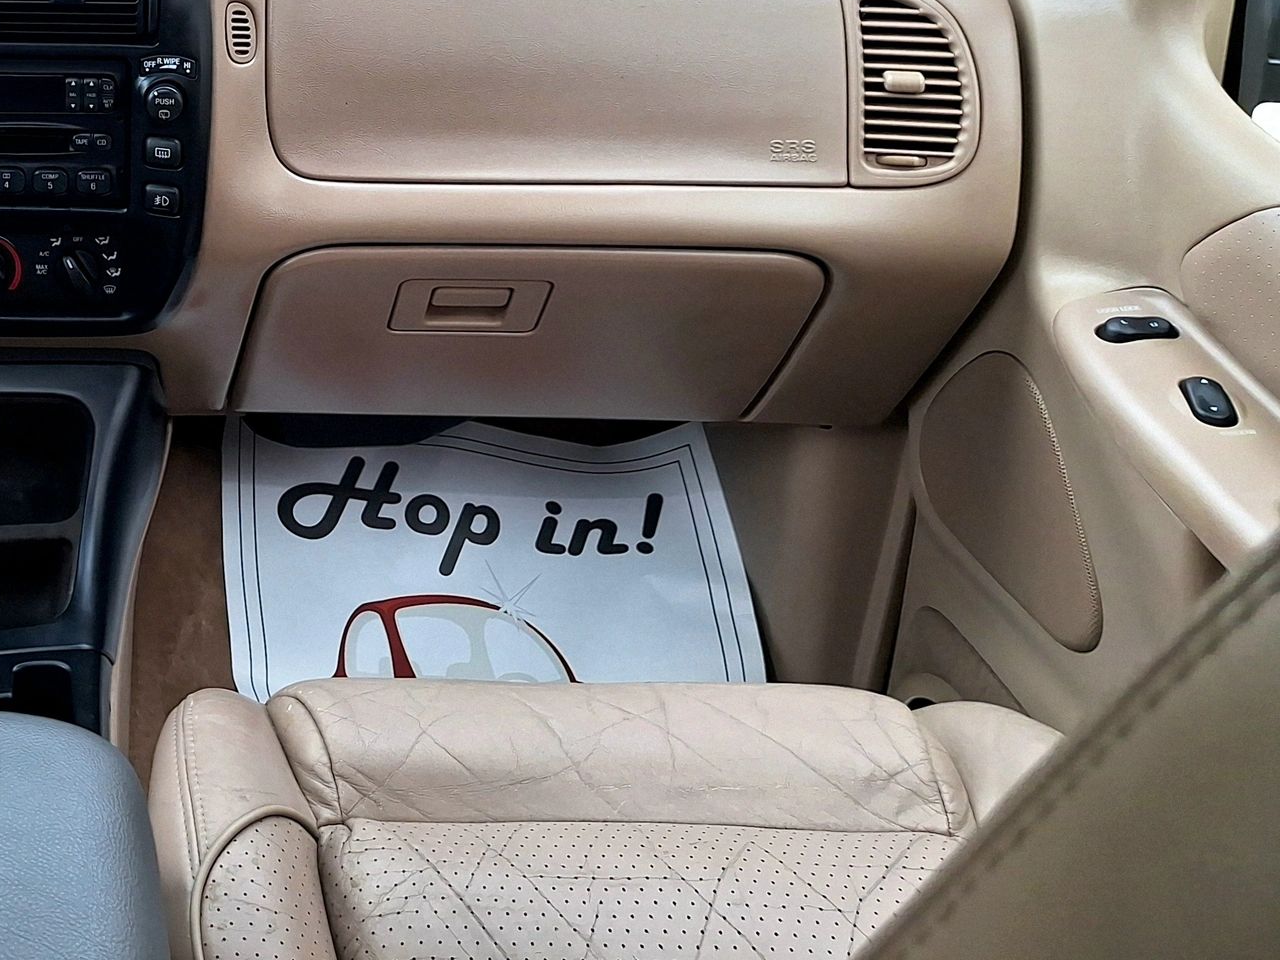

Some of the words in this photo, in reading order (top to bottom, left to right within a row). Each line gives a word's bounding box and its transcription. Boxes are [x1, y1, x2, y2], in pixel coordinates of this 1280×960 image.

[143, 60, 157, 68] OFF
[770, 139, 817, 154] SRS
[770, 153, 818, 163] AIRBAG
[3, 181, 9, 189] 4
[47, 182, 53, 190] 5
[90, 182, 96, 190] 6
[277, 456, 501, 577] Hop
[535, 493, 664, 557] in!
